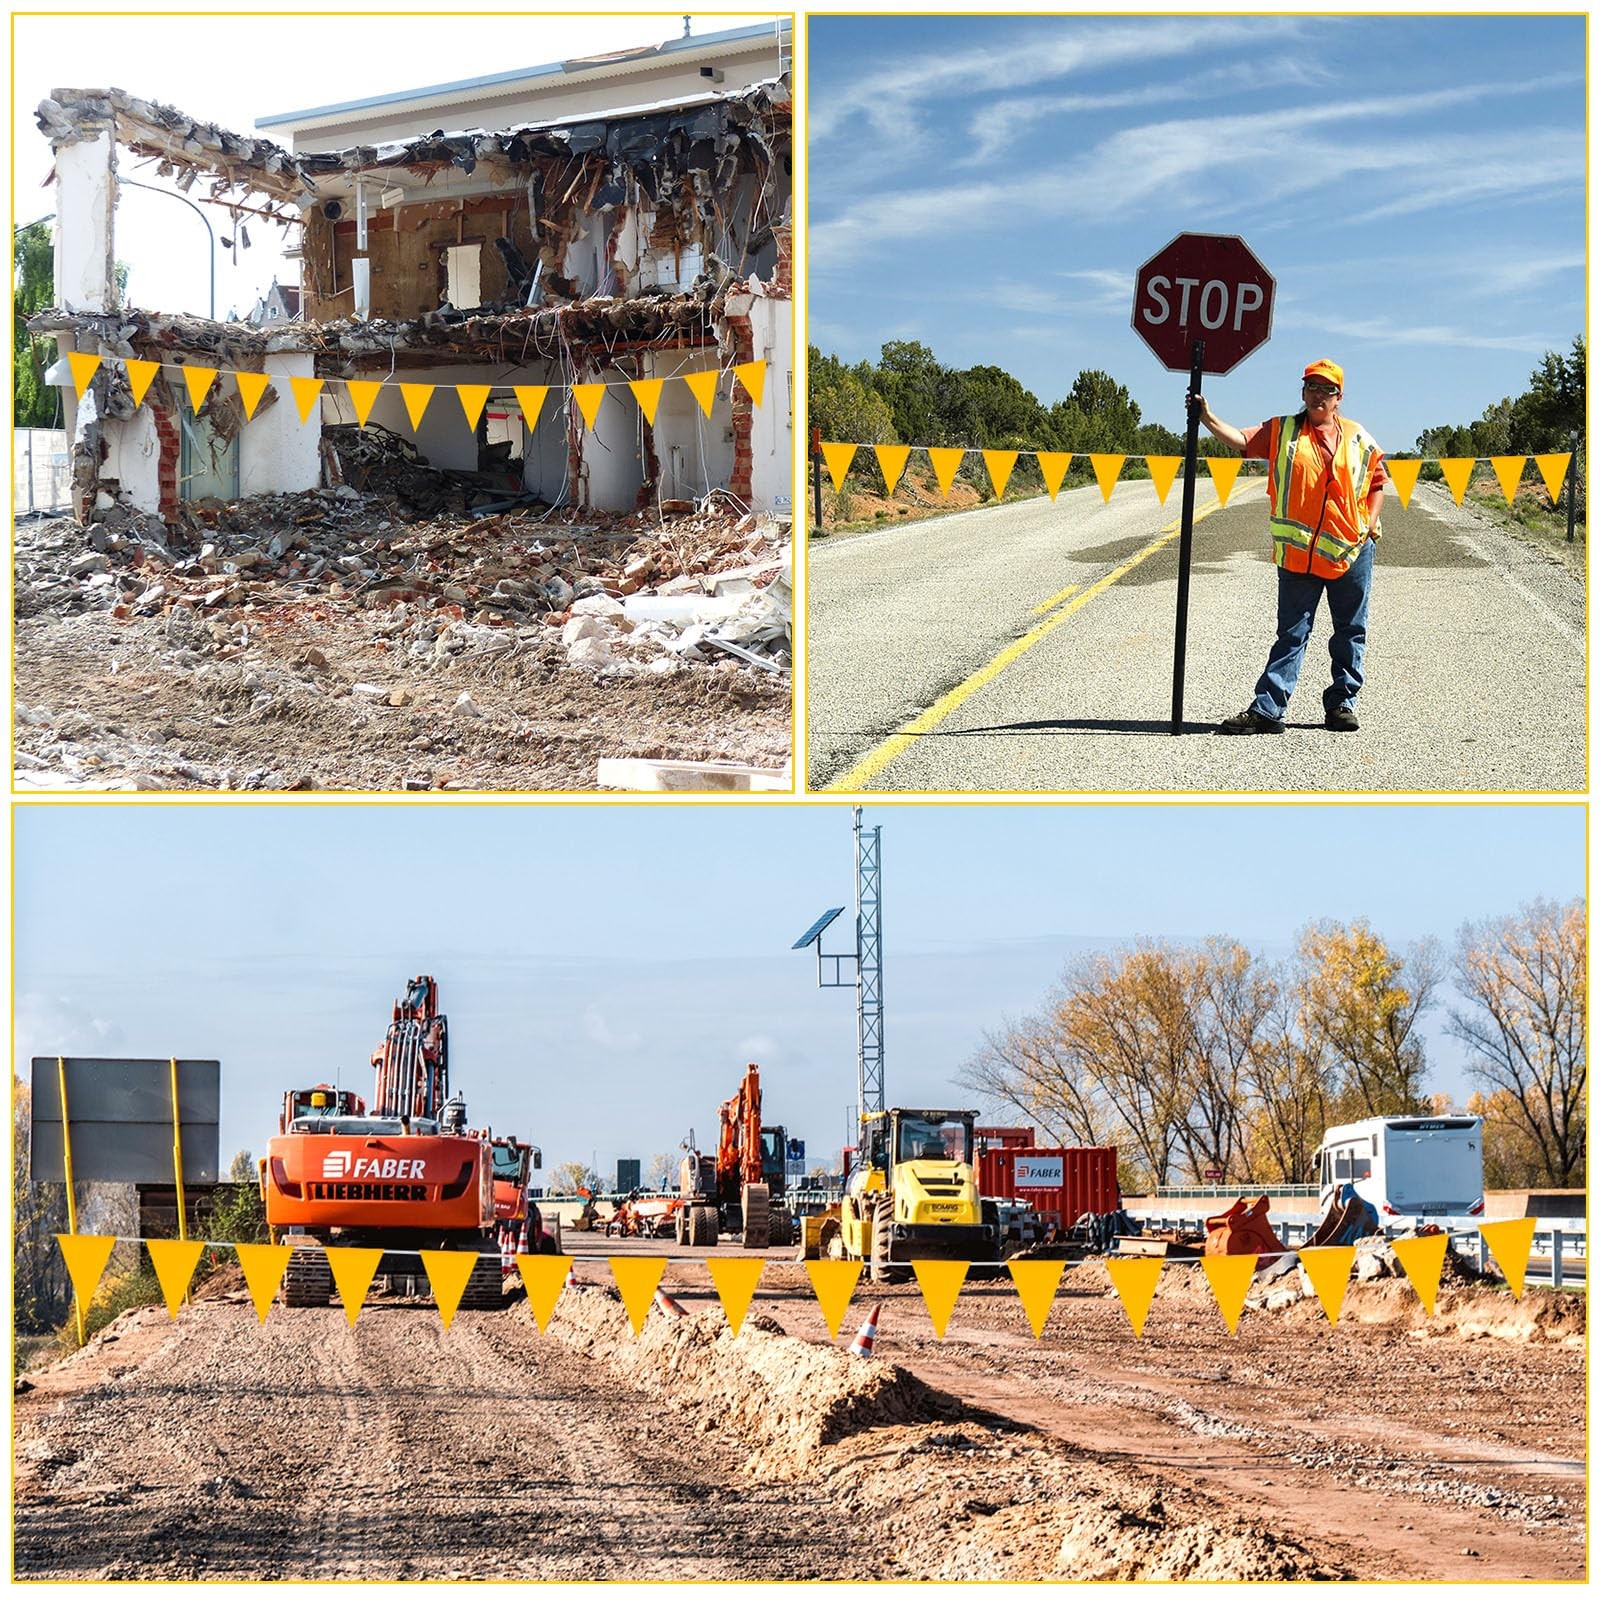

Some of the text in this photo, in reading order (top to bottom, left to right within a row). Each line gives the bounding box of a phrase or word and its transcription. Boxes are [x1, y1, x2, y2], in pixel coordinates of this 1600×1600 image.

[1143, 275, 1264, 331] STOP
[353, 1158, 426, 1179] FABER
[1030, 1168, 1061, 1178] FABER
[315, 1183, 427, 1200] LIEBHERR
